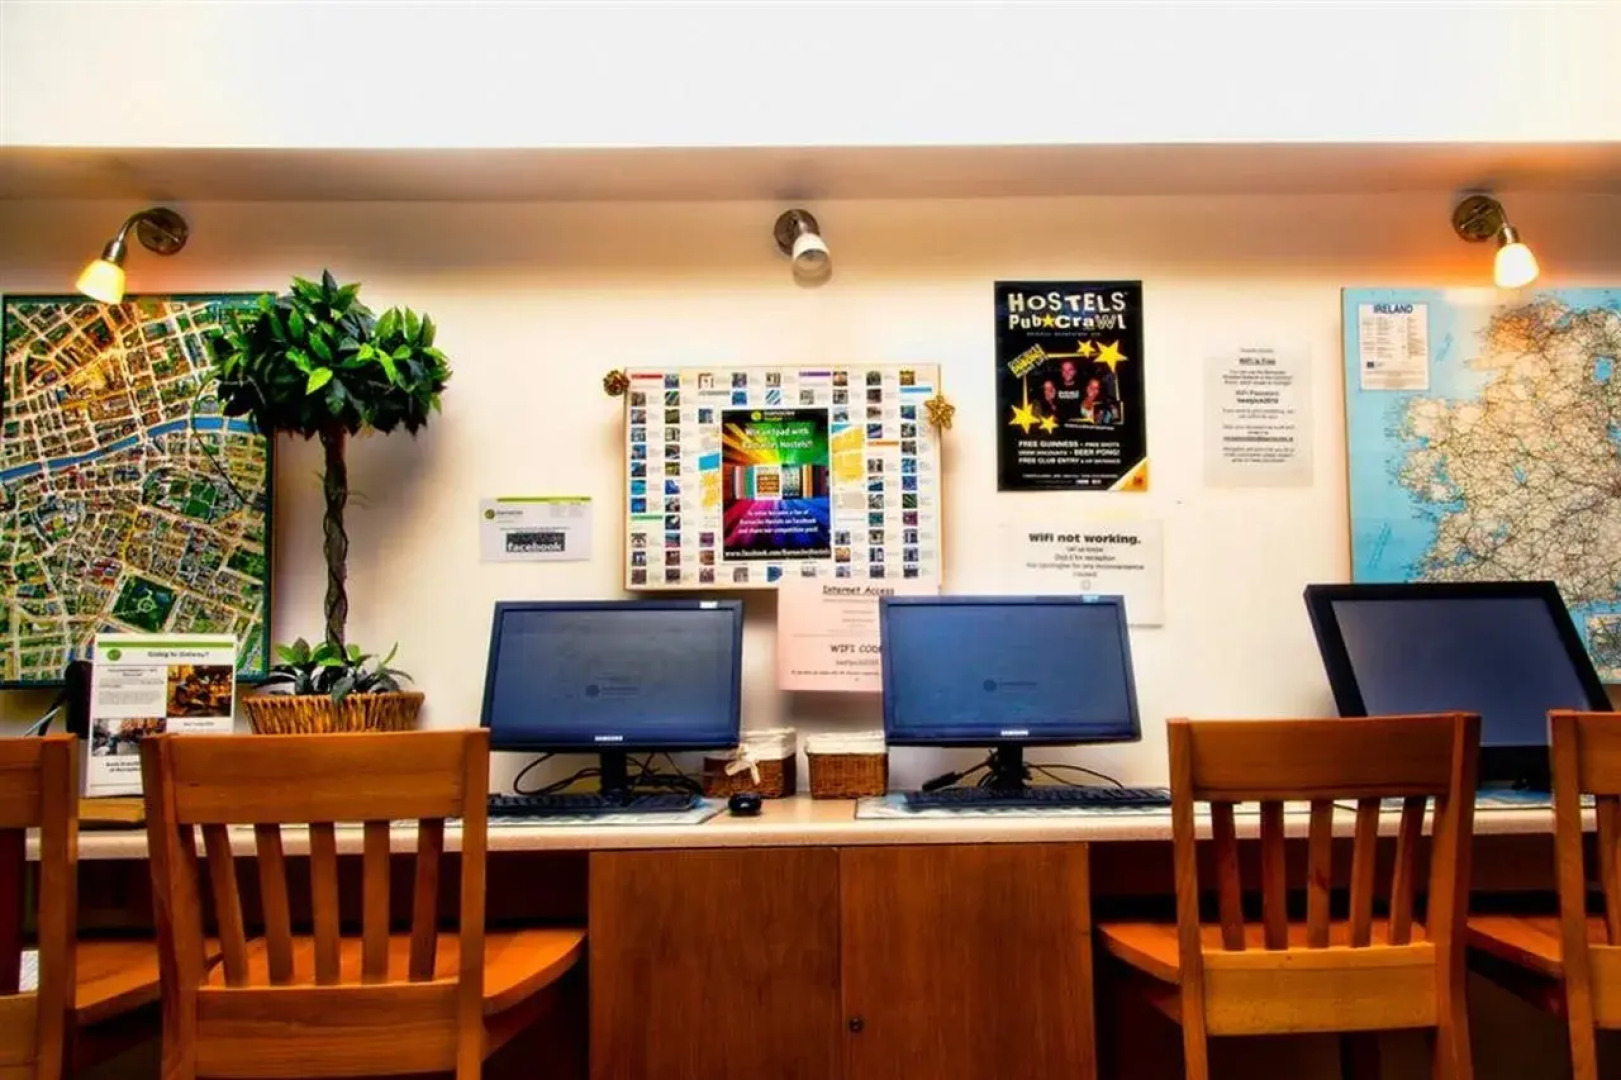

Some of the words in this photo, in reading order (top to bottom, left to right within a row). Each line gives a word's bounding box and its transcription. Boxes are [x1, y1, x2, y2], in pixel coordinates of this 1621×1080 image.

[1373, 303, 1413, 314] IRELAND
[1009, 314, 1042, 330] Pub
[1057, 534, 1080, 543] not
[1083, 534, 1141, 545] working.
[507, 541, 562, 552] facebook
[823, 585, 860, 594] Internet
[830, 644, 855, 653] WIFI
